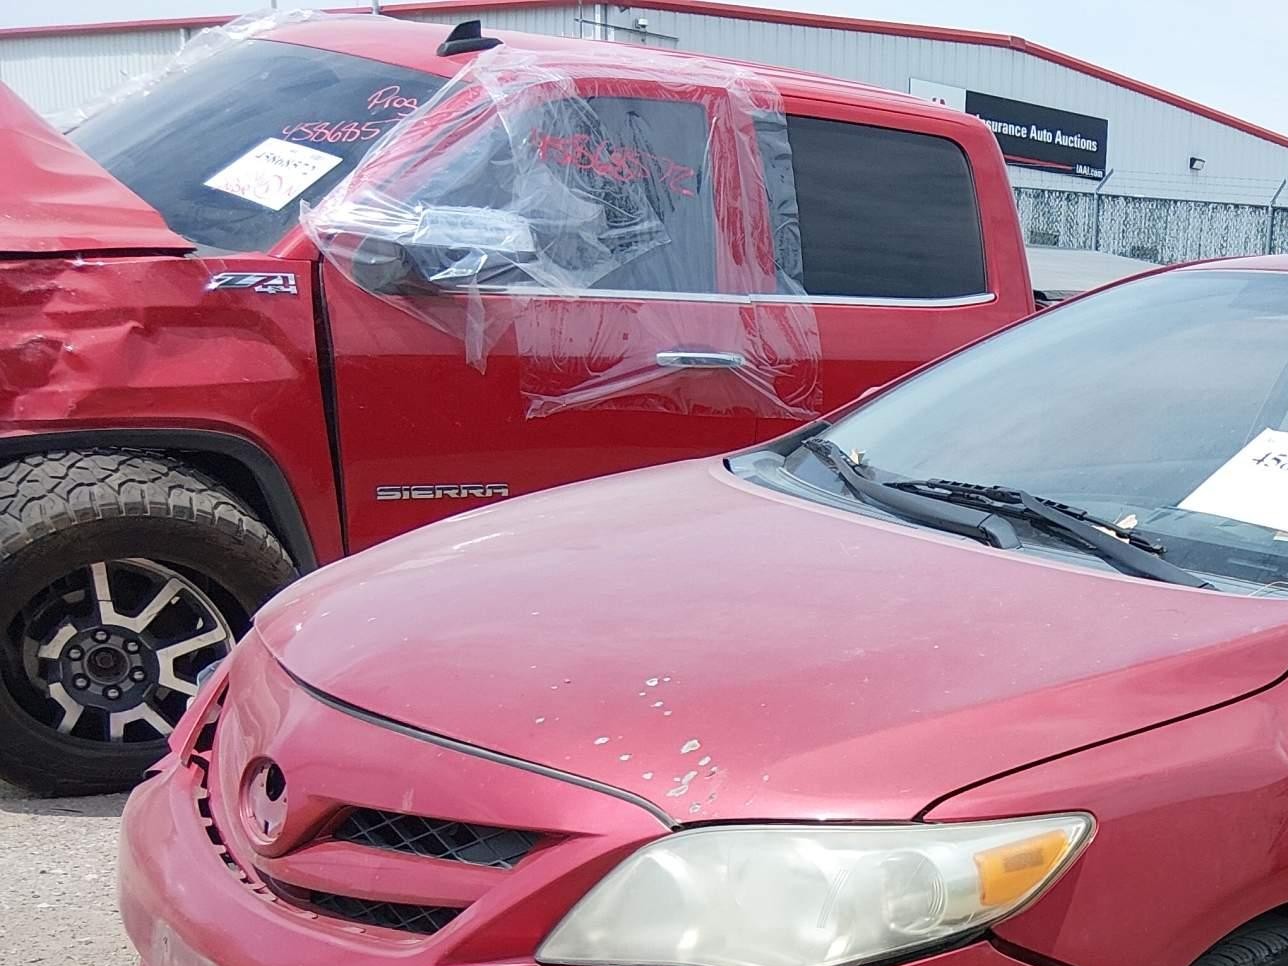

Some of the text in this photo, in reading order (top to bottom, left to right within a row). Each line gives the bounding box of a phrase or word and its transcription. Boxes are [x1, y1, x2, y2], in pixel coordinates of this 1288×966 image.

[976, 114, 1098, 152] surance Auto Auctions
[376, 483, 509, 501] SIERRA
